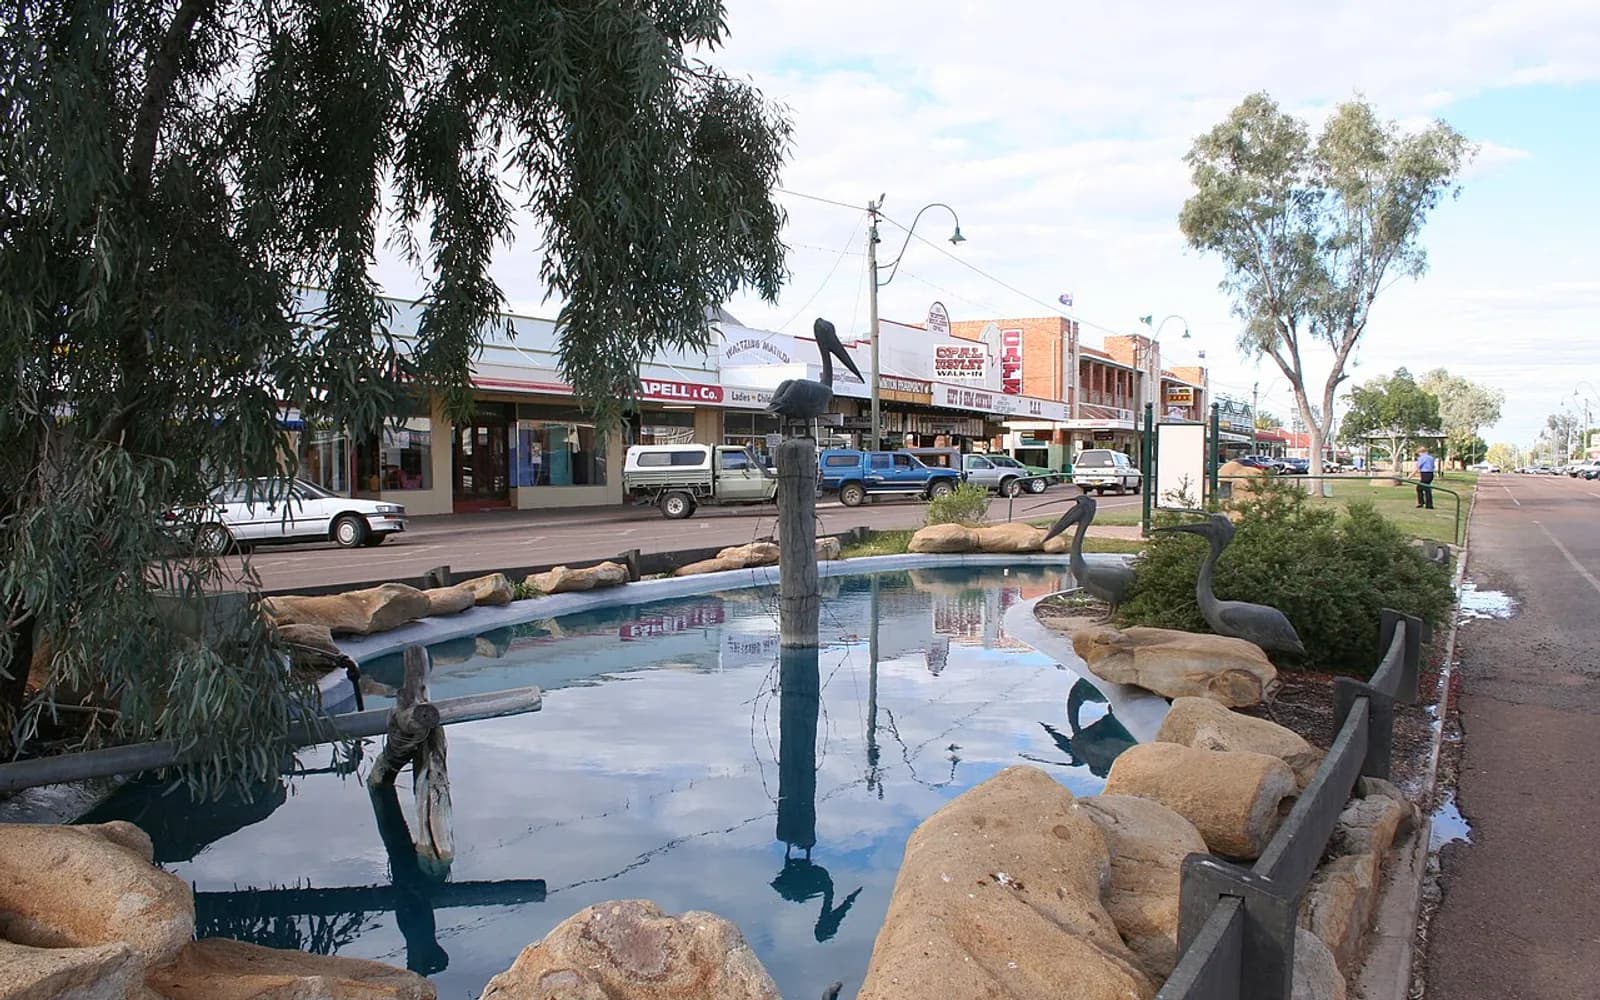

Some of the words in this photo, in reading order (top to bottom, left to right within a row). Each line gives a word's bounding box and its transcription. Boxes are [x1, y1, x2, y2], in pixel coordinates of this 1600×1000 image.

[762, 341, 790, 364] MATILDA
[936, 347, 984, 358] OPAL
[700, 387, 718, 400] Co.
[731, 391, 750, 402] Ladies
